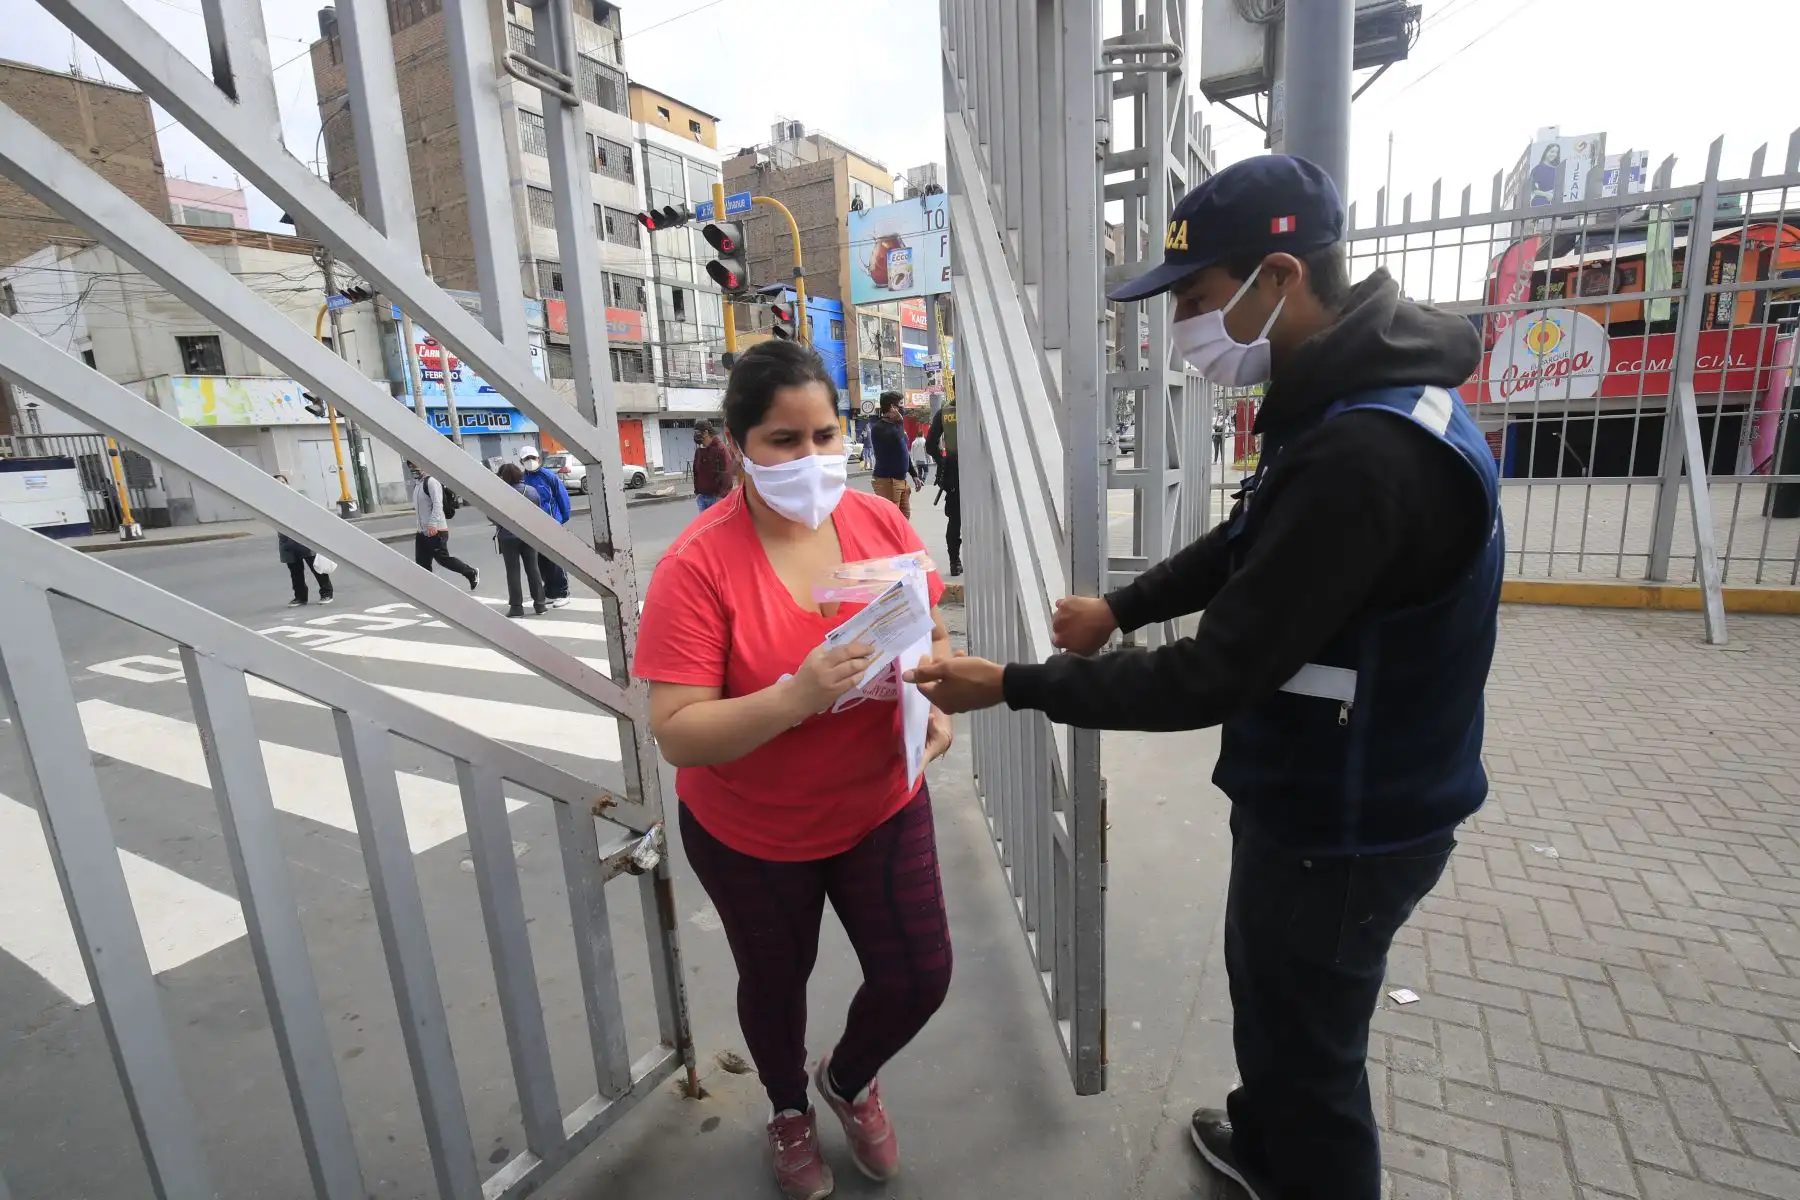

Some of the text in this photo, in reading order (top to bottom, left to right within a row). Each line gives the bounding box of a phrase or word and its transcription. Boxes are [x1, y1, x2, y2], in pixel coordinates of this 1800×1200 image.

[924, 201, 945, 231] TÓ
[1165, 219, 1188, 251] CA
[943, 413, 956, 423] POL
